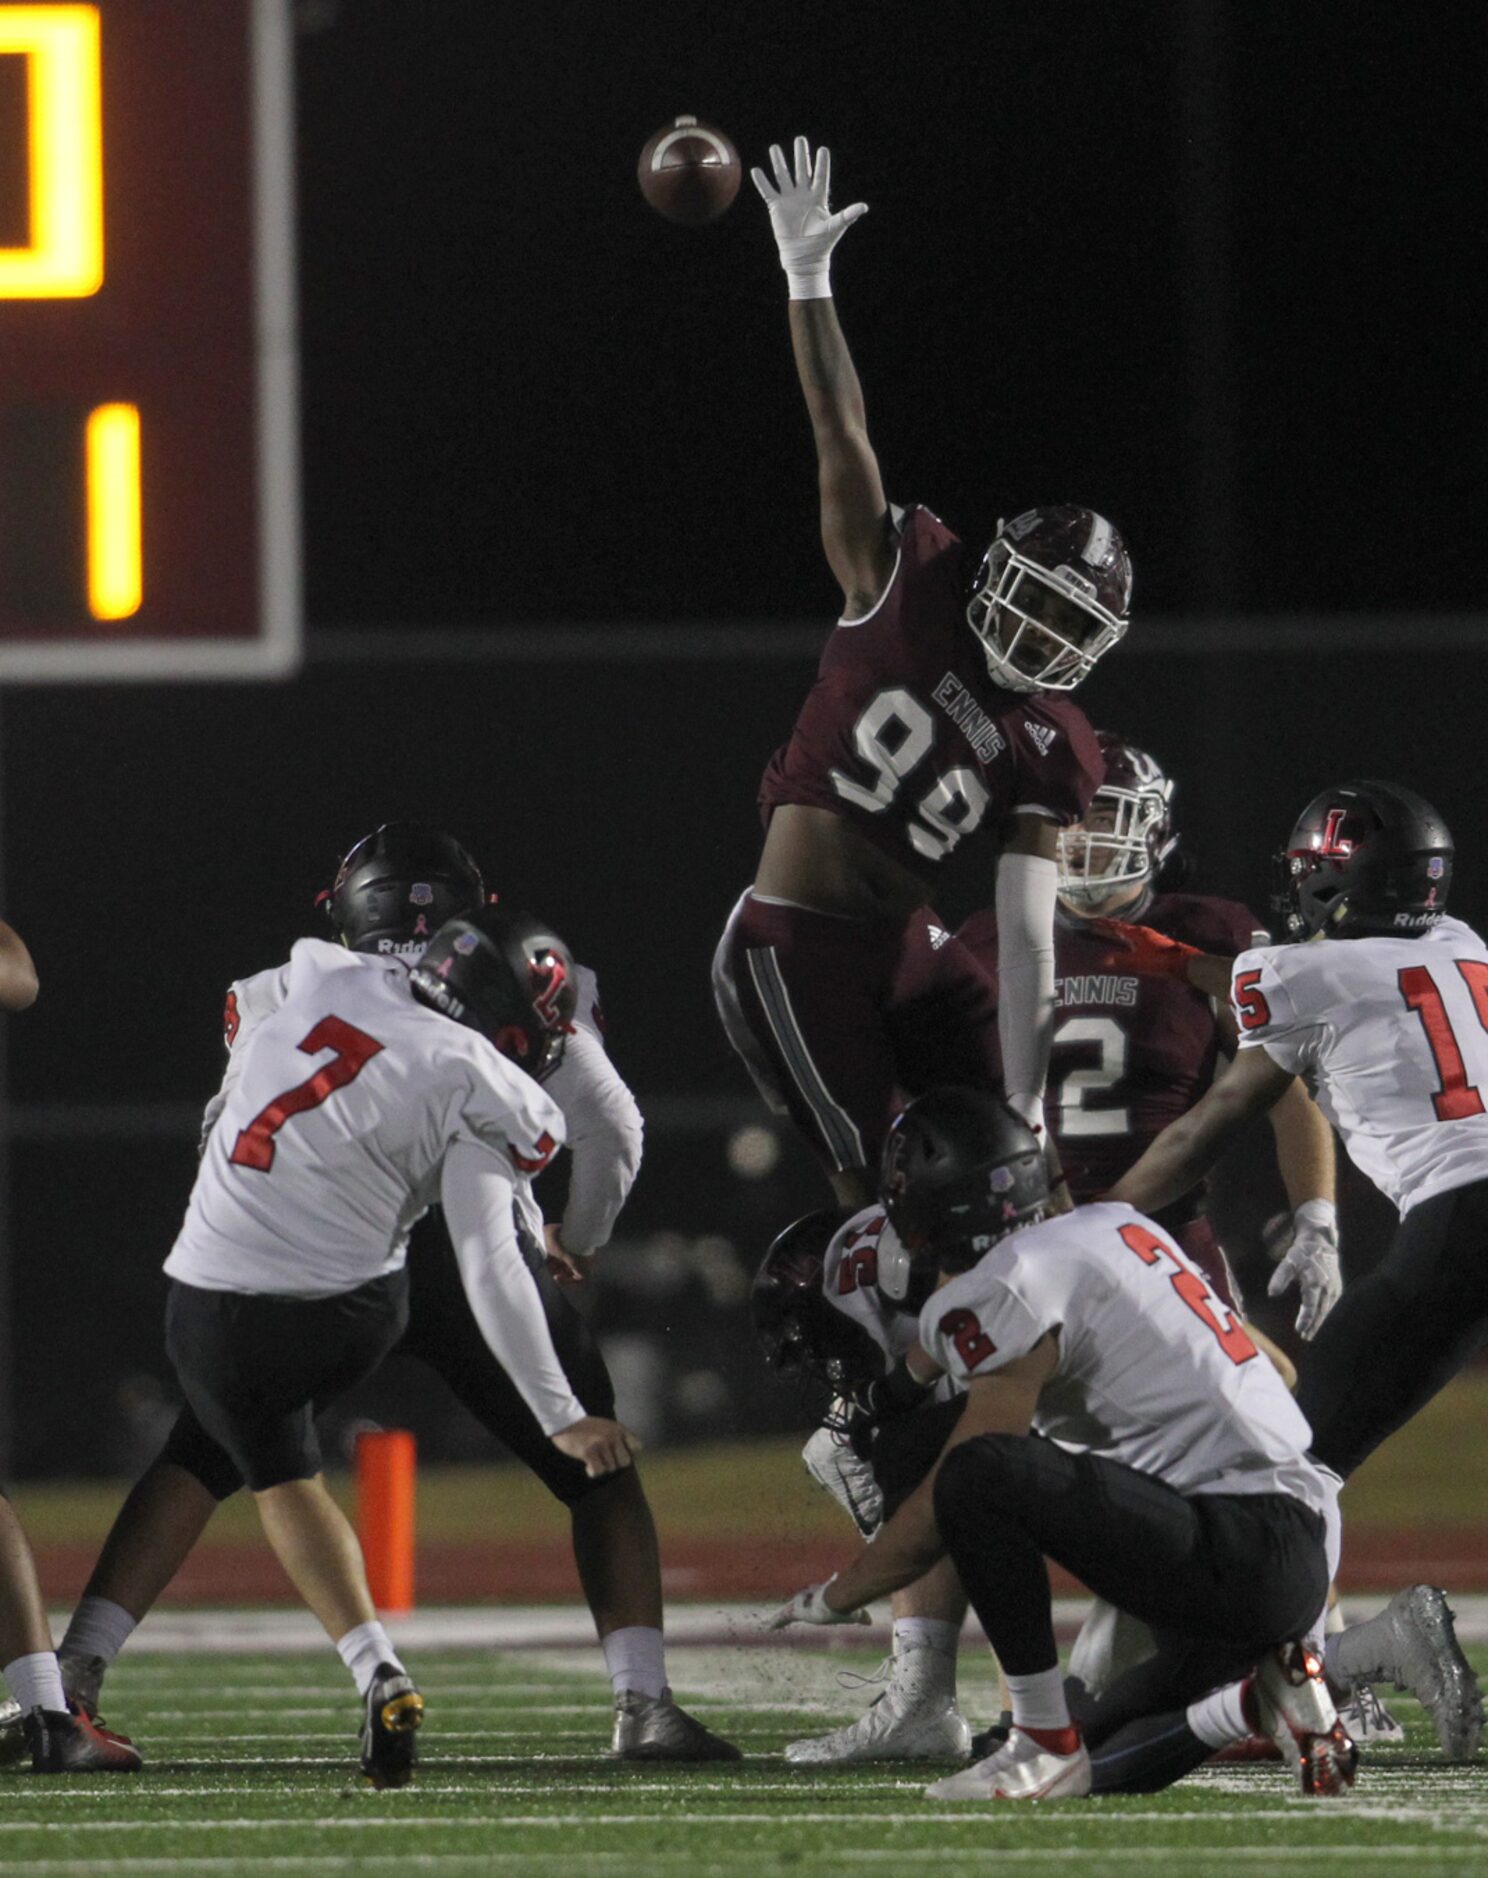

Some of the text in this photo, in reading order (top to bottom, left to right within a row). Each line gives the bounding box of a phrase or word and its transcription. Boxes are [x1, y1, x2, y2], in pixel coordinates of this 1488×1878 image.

[86, 403, 142, 620] 1
[829, 684, 990, 861] 99
[932, 671, 1006, 764] ENNIS
[1321, 809, 1352, 859] L
[1235, 968, 1271, 1031] 5
[229, 1014, 386, 1174] 7
[1054, 1017, 1127, 1135] 2
[1116, 1222, 1259, 1366] 2
